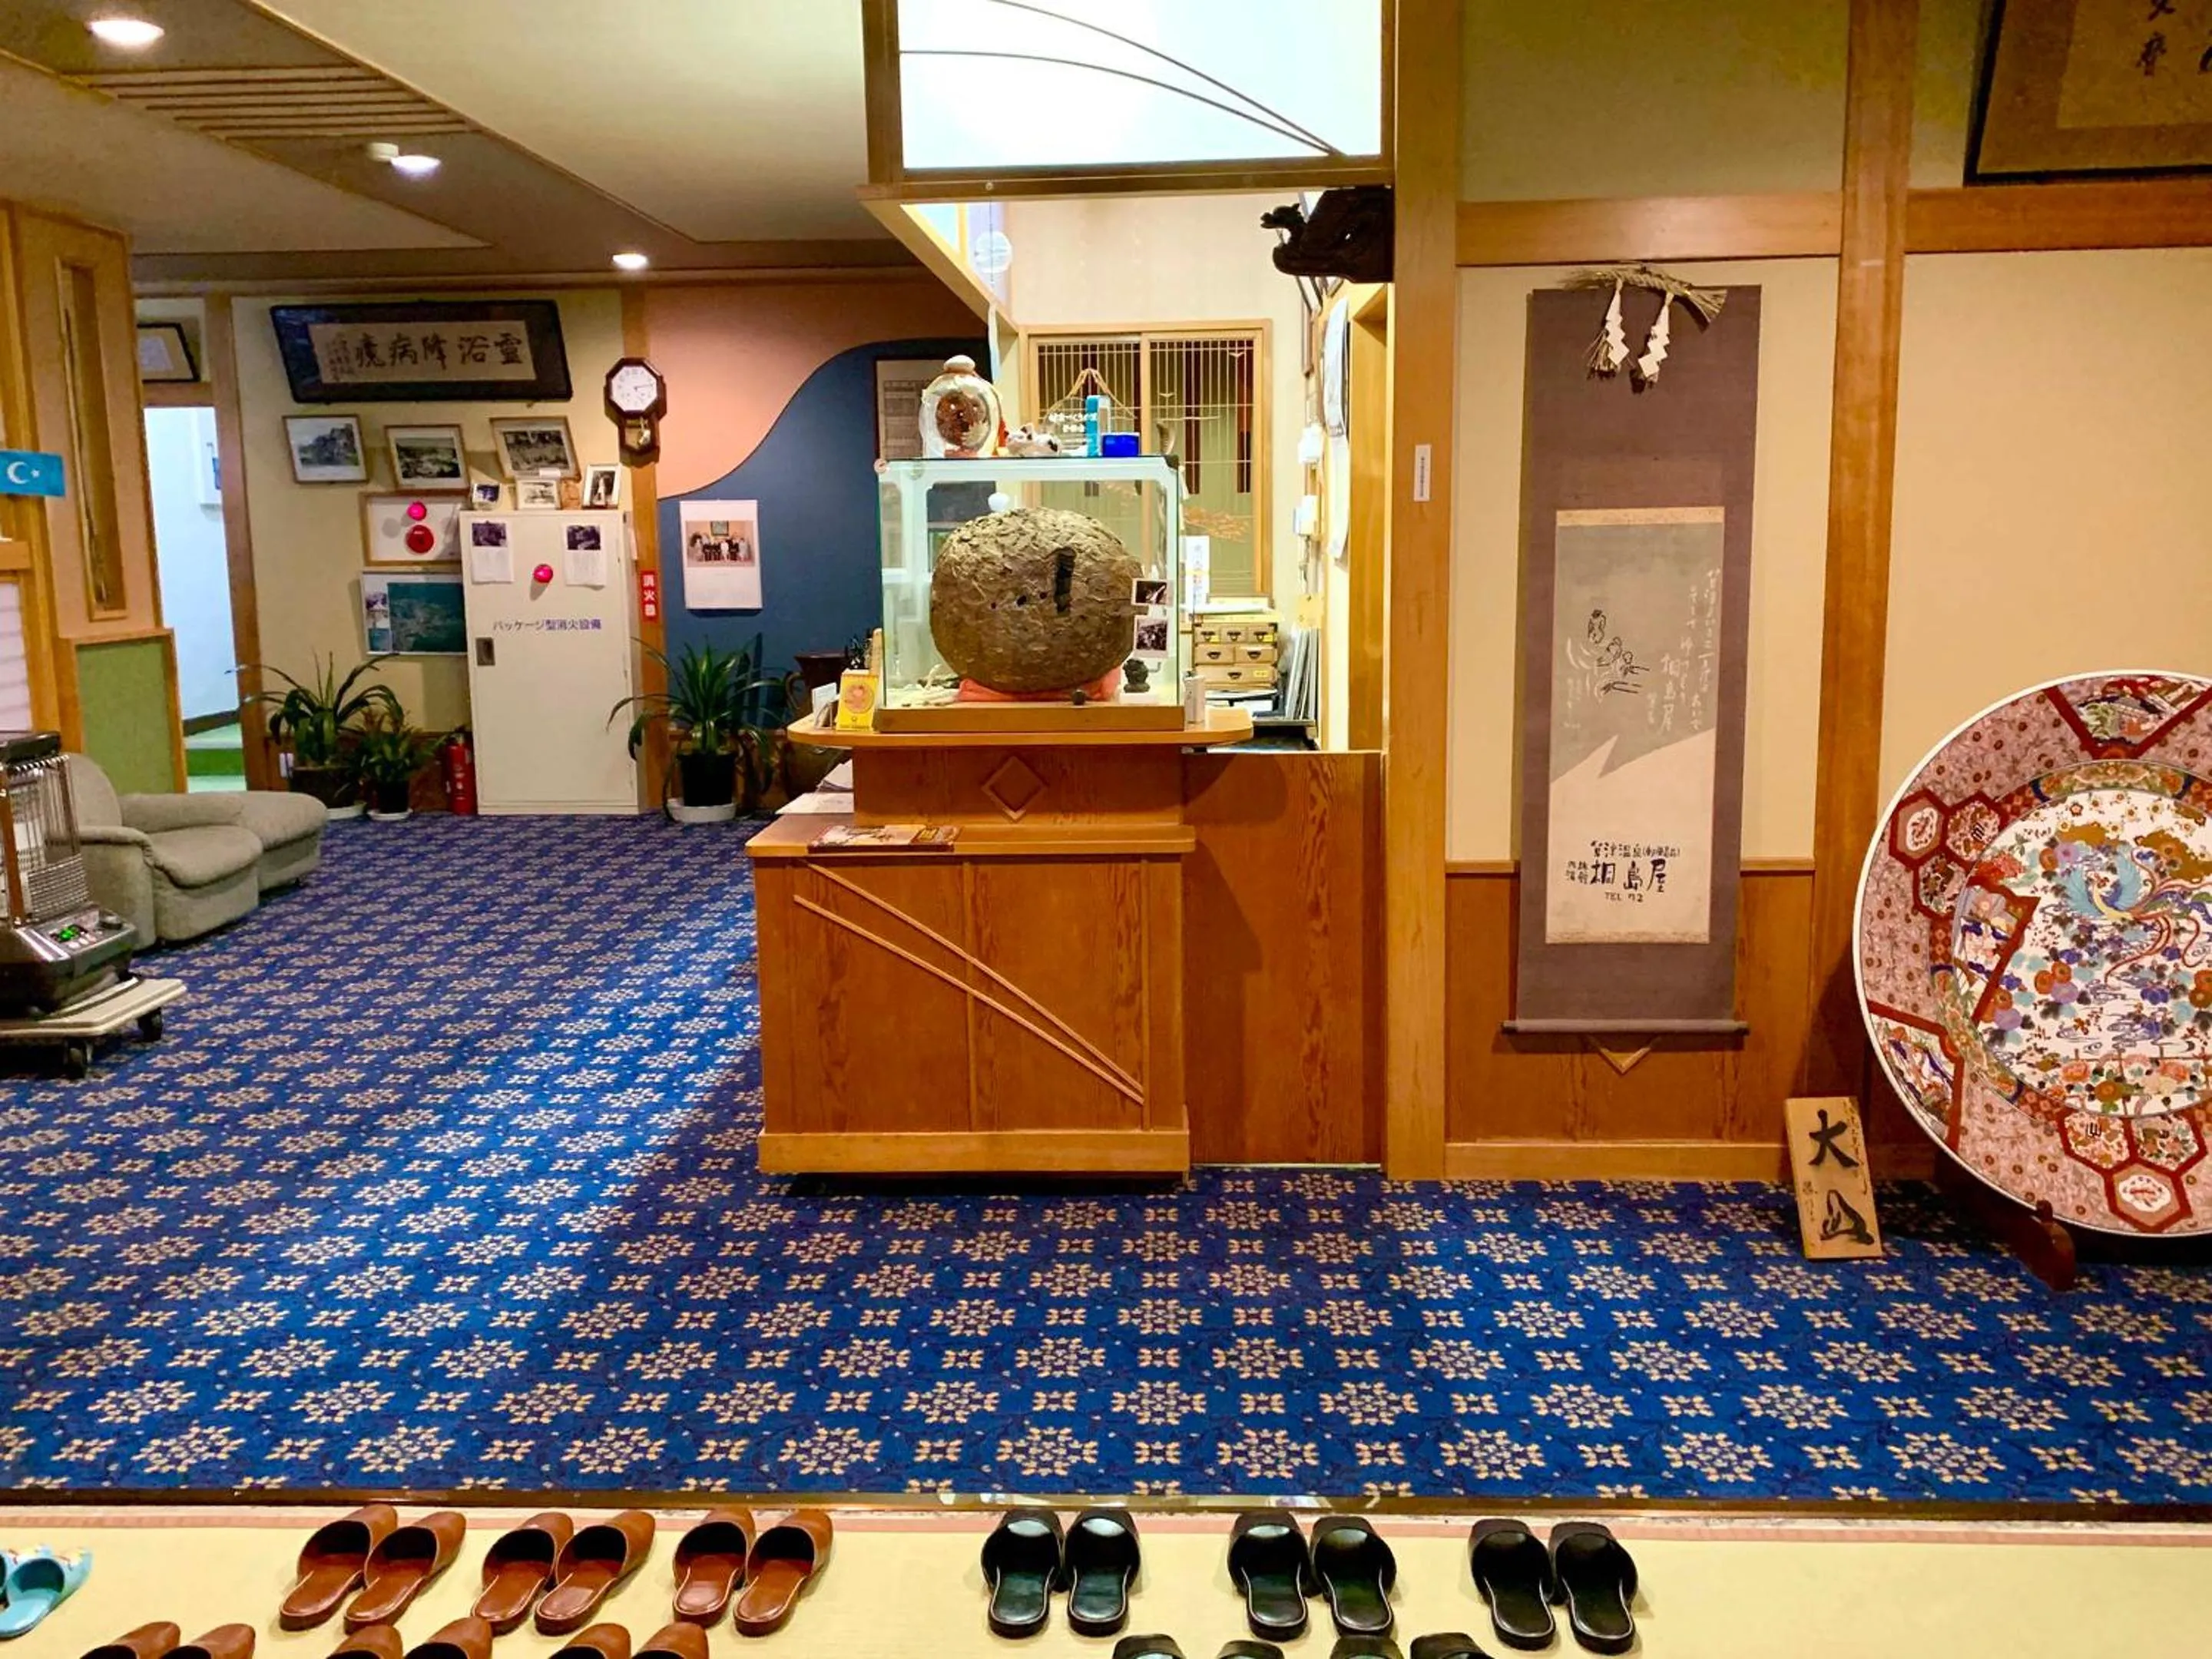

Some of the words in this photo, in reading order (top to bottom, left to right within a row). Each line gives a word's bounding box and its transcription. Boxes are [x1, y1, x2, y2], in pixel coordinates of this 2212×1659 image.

[642, 574, 657, 617] 消火器
[492, 618, 603, 632] パッケージ型消火設備
[1604, 892, 1622, 902] TEL
